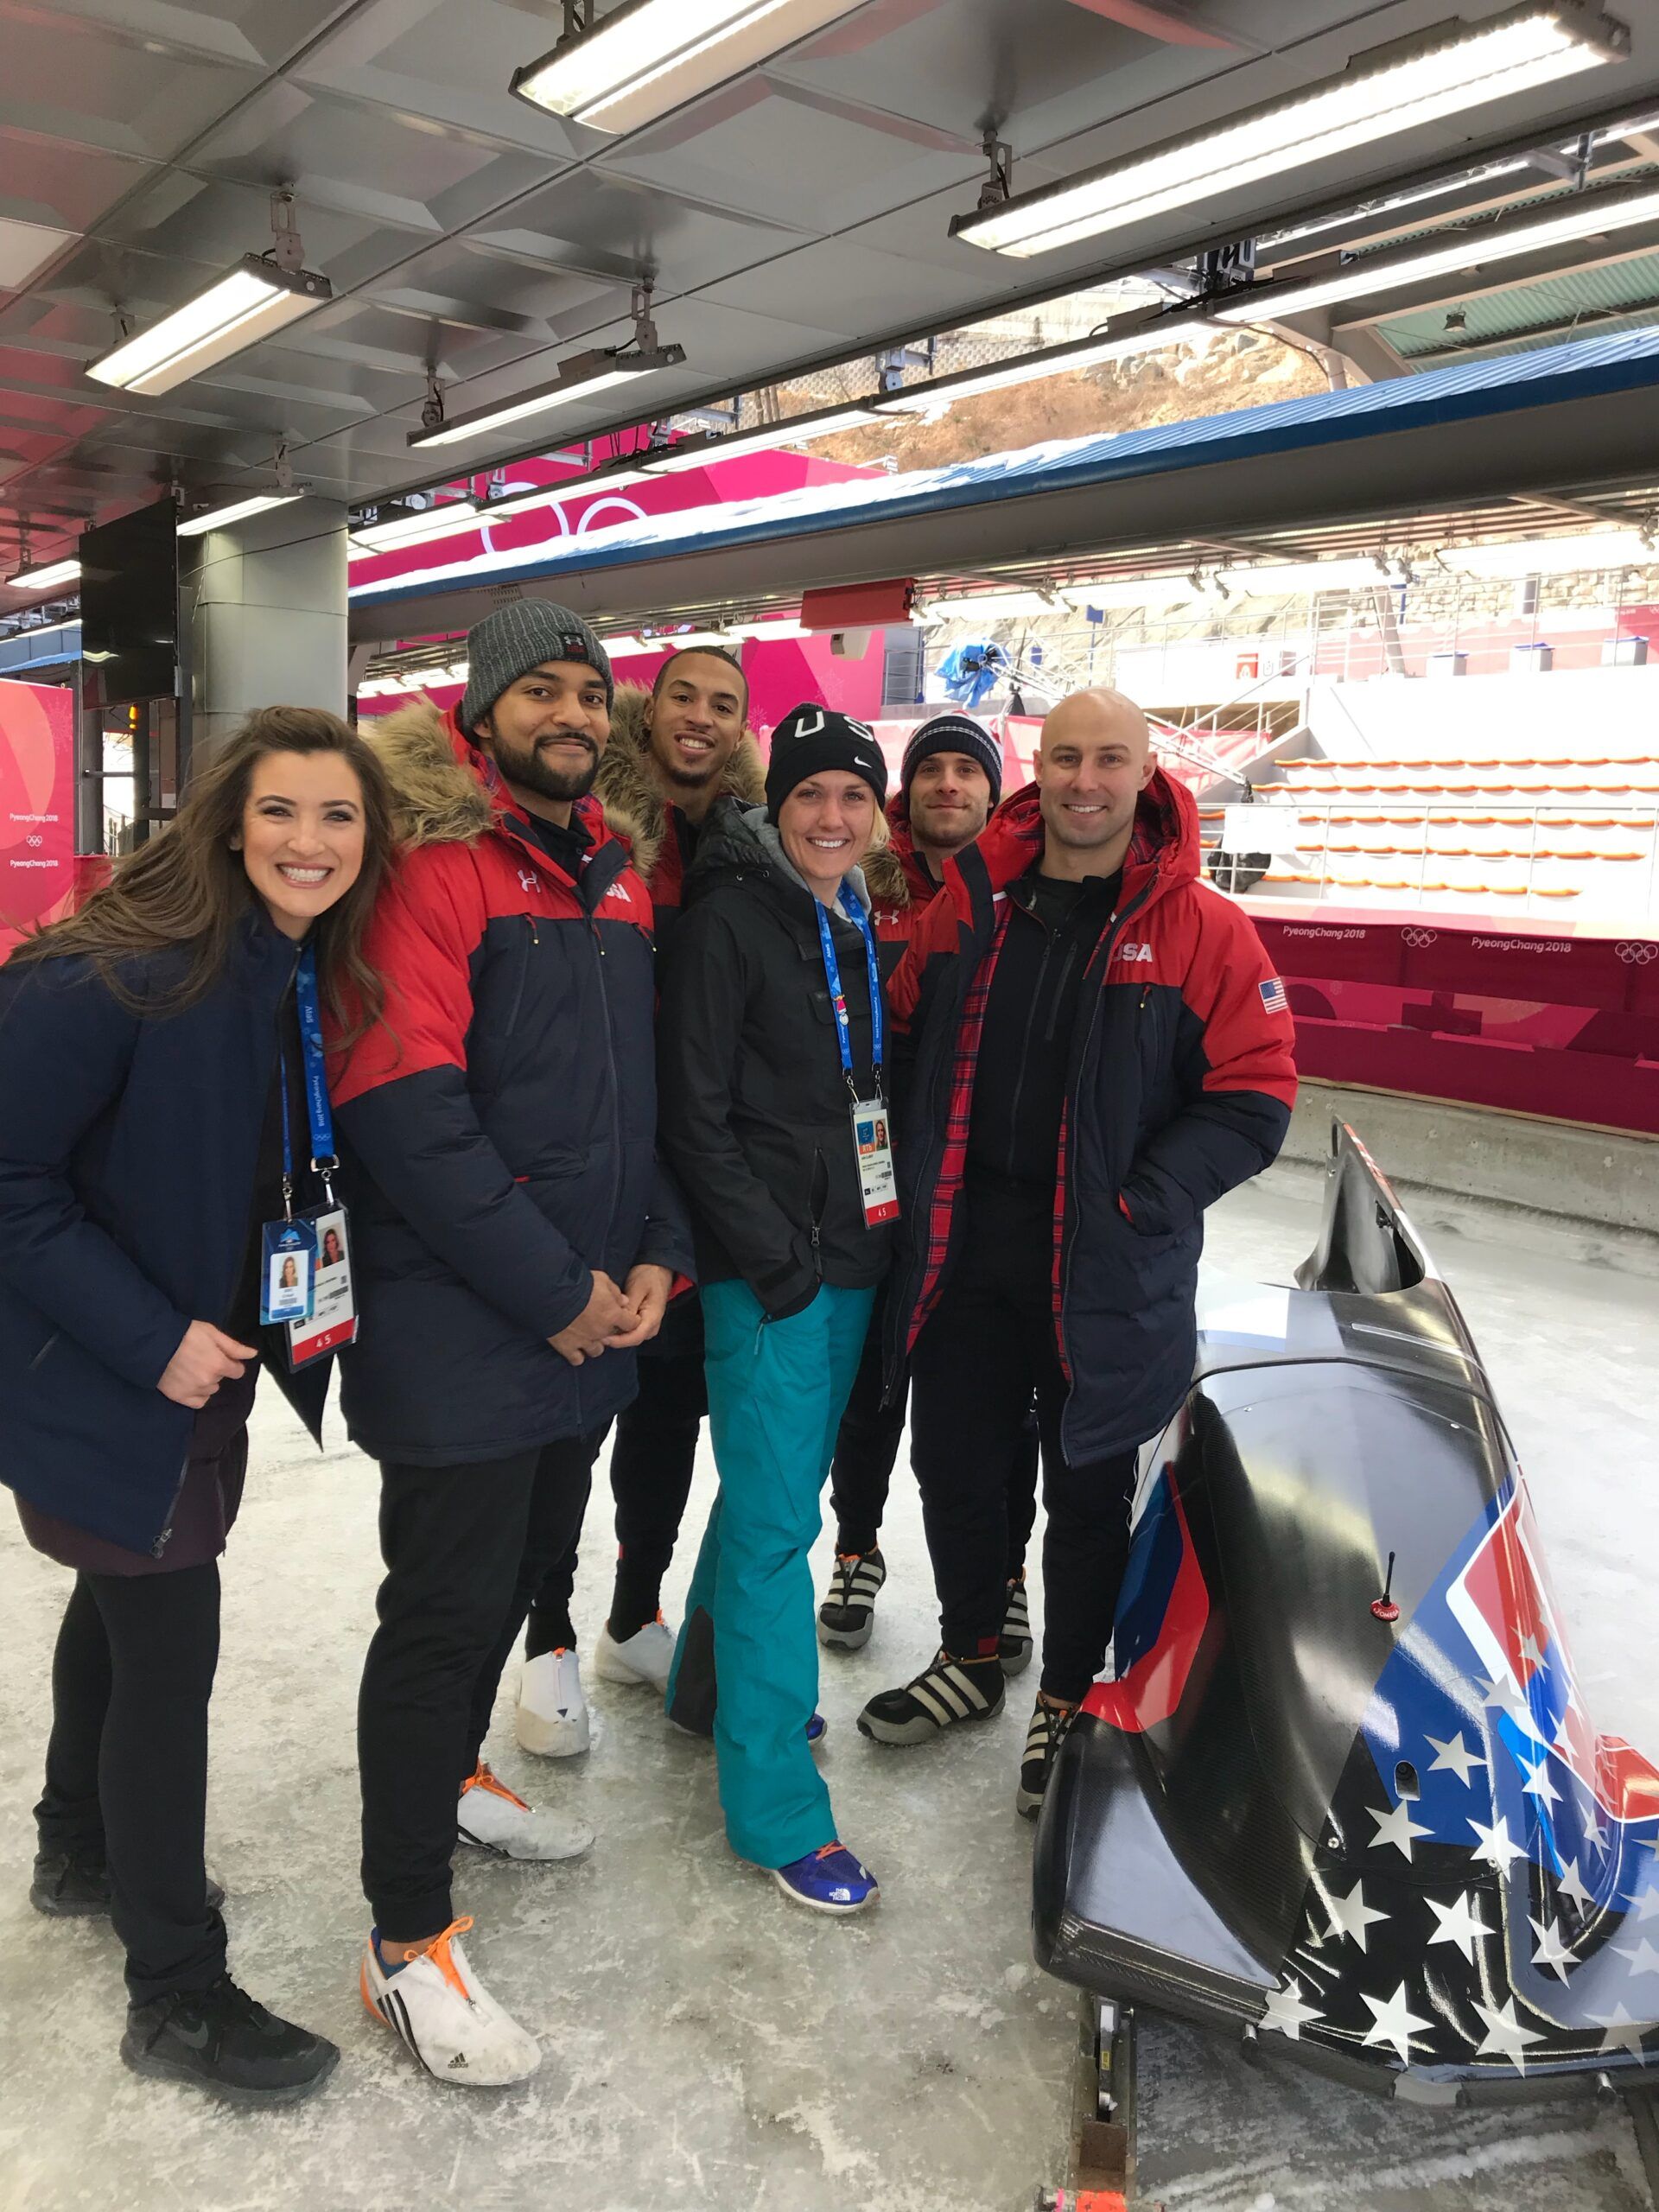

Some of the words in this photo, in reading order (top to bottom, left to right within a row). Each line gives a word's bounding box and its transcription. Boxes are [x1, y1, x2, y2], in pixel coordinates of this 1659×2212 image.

[10, 813, 46, 823] PyeongChang
[10, 860, 46, 868] PyeongChang
[1283, 925, 1343, 939] PyeongChang
[1344, 929, 1366, 938] 2018
[1471, 937, 1544, 953] PyeongChang
[1545, 941, 1572, 952] 2018
[312, 1075, 323, 1114] PyeongChang
[316, 1114, 325, 1127] 2018
